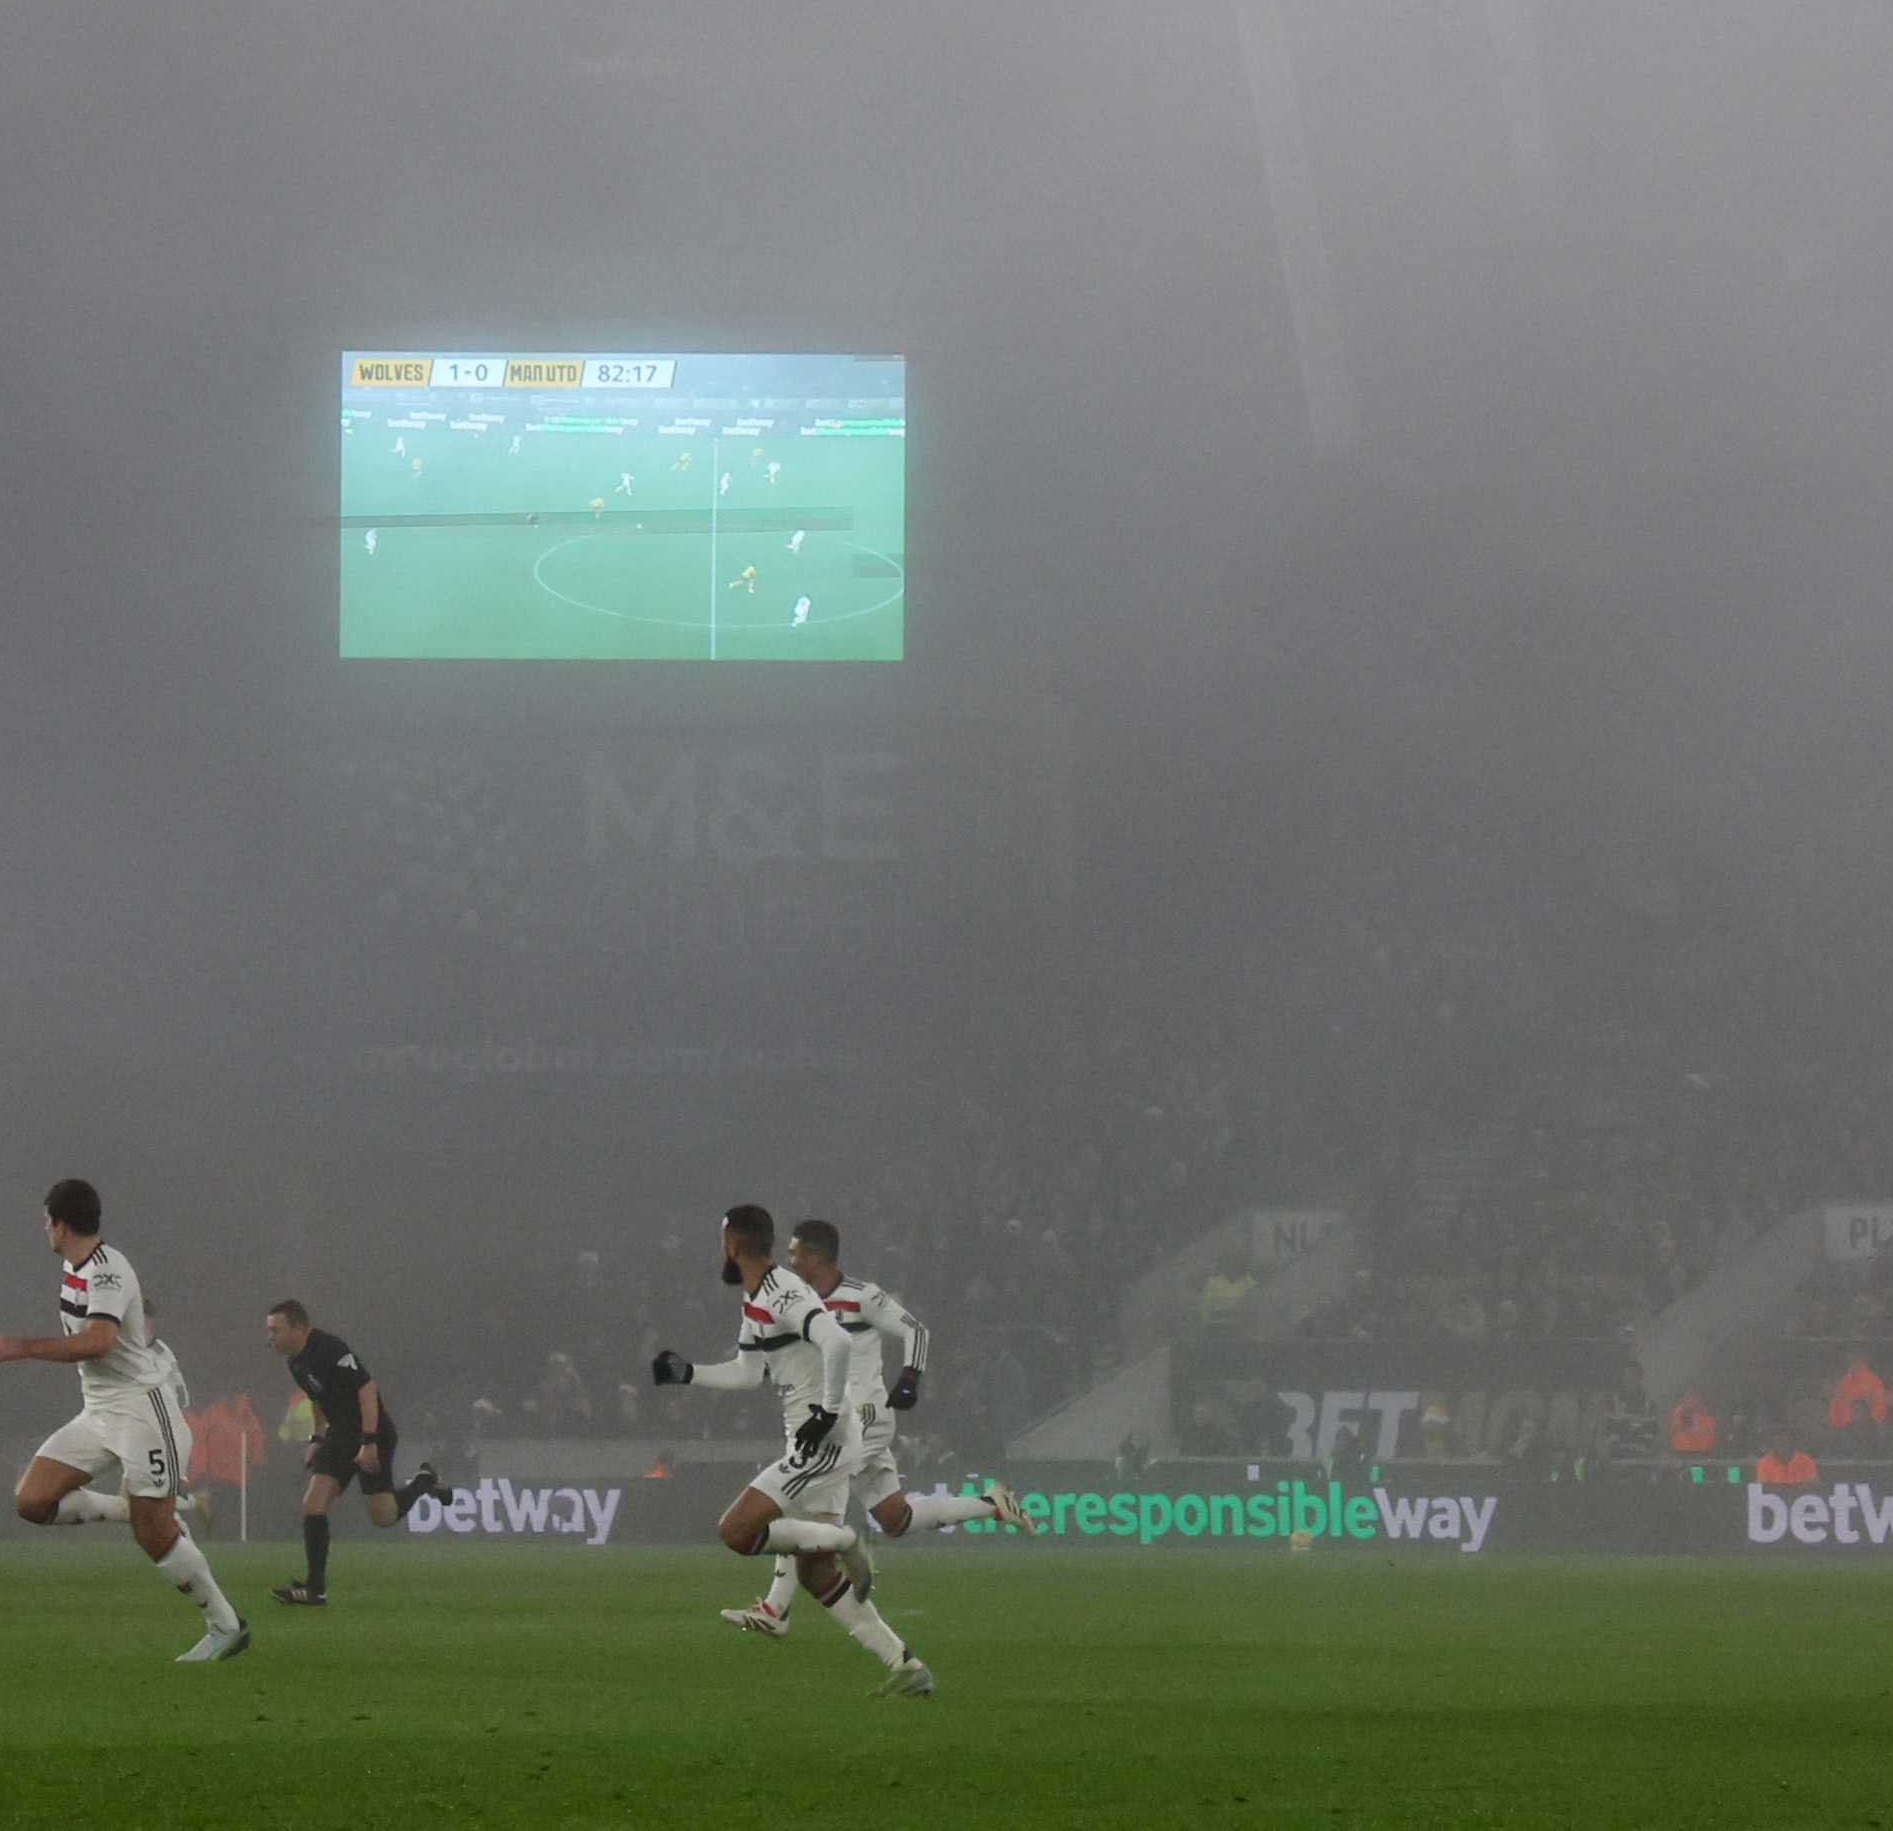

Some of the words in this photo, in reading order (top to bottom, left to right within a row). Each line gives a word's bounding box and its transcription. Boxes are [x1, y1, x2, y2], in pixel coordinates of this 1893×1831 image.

[359, 363, 424, 382] WOLVES
[510, 365, 542, 383] MAN
[545, 365, 577, 383] UTD
[598, 364, 657, 383] 82:17
[583, 754, 901, 862] M&E
[149, 1449, 165, 1476] 5
[407, 1478, 621, 1545] betway
